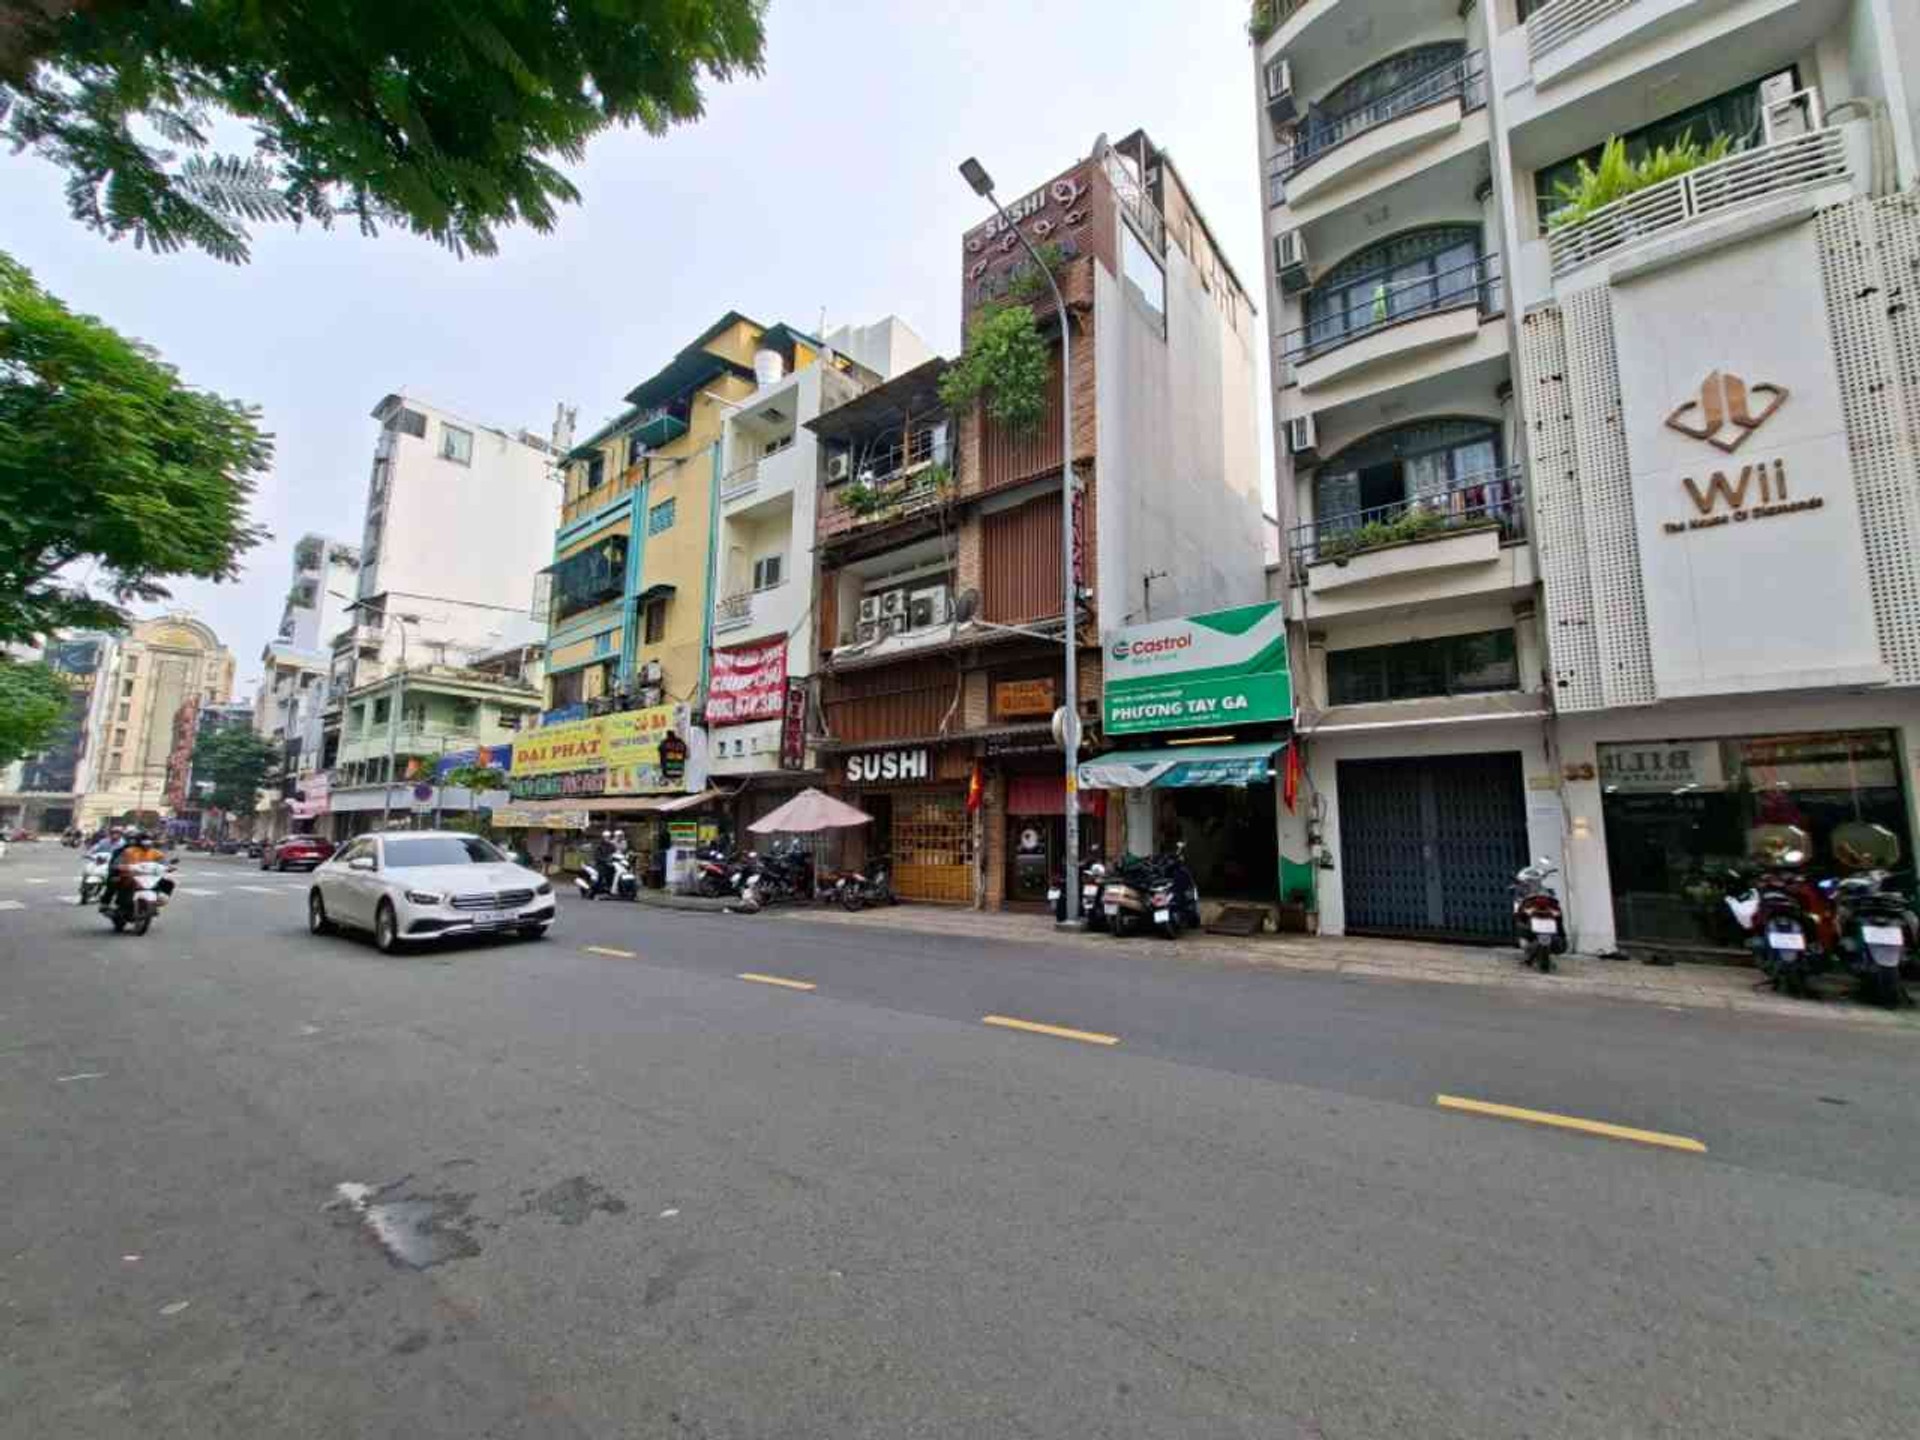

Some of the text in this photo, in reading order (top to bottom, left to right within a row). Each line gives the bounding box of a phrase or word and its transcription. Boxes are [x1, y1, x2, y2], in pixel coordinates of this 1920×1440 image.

[985, 189, 1046, 240] SUSHI
[1682, 458, 1788, 514] Wii
[1131, 633, 1193, 655] Castrol
[1186, 697, 1218, 713] TAY
[846, 750, 928, 782] SUSHI
